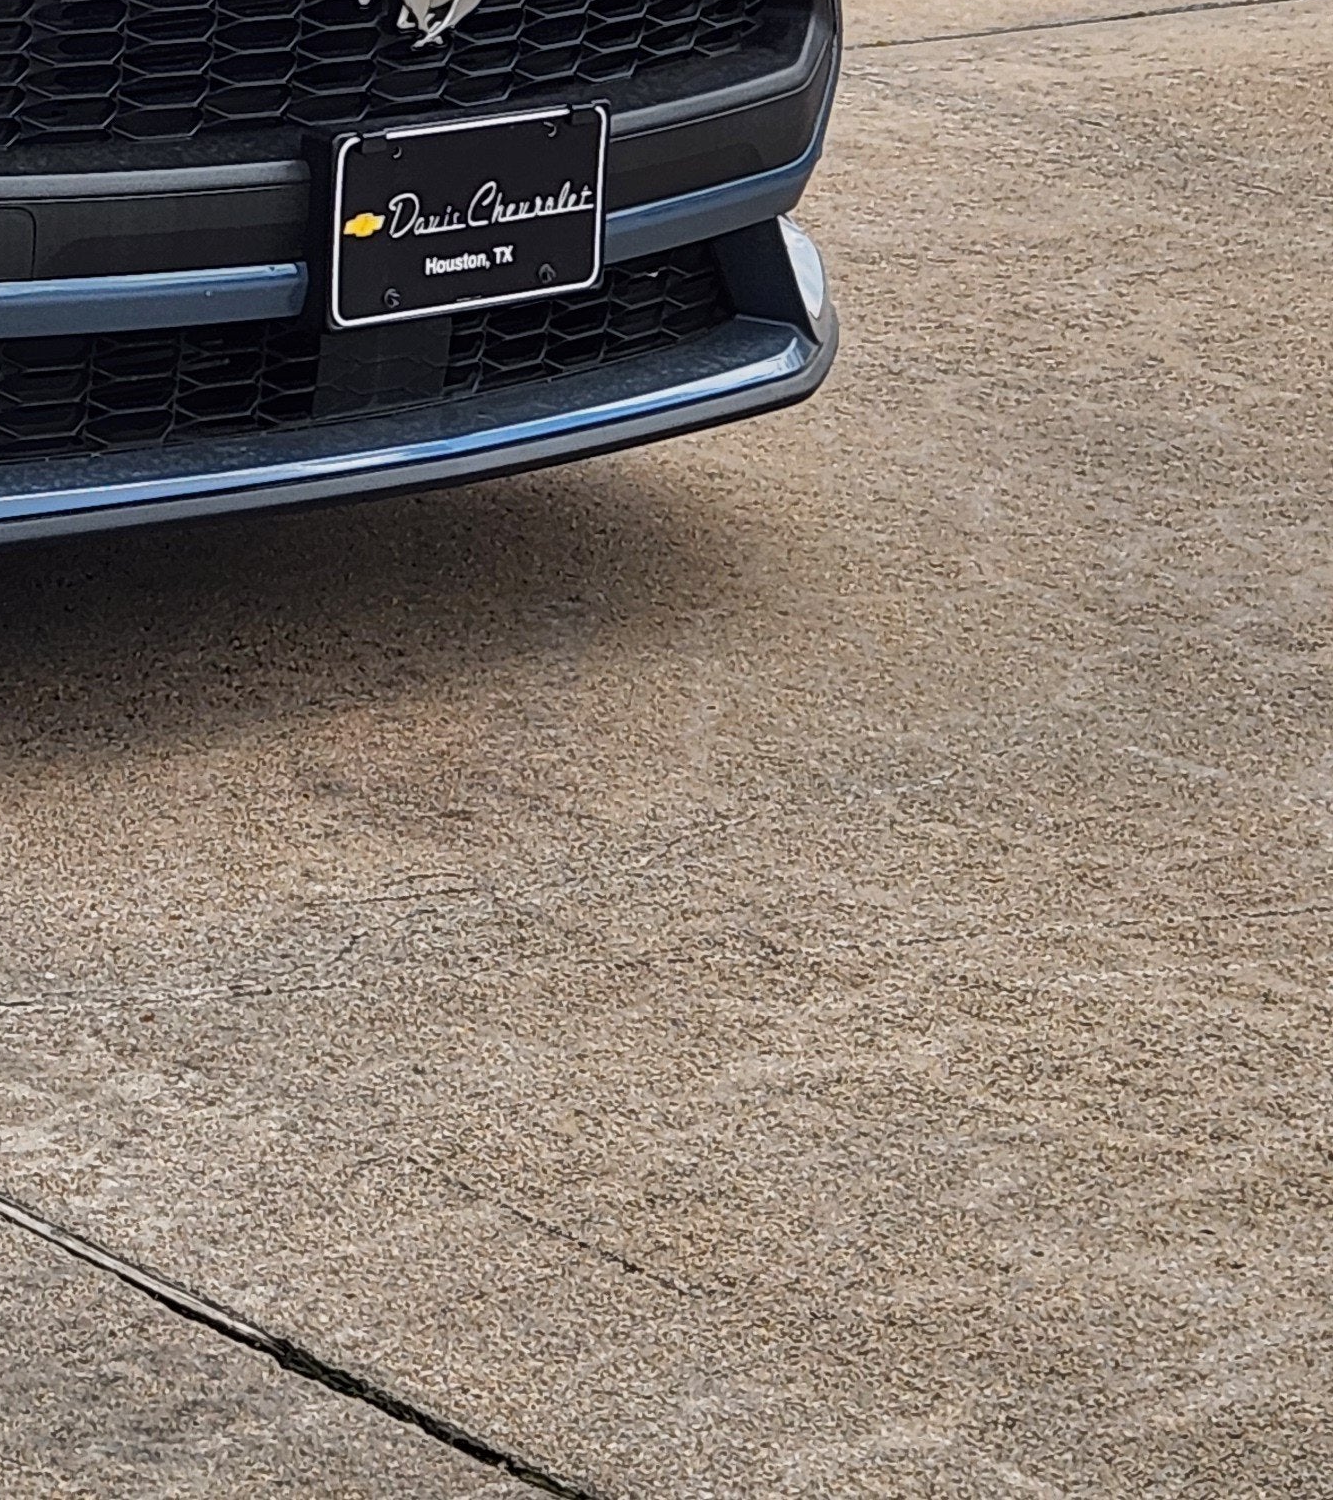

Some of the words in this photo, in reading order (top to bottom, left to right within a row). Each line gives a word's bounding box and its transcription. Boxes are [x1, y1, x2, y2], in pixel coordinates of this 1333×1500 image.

[388, 192, 467, 238] Davis
[467, 180, 595, 227] Chevrolet
[425, 251, 491, 276] Houston,
[492, 245, 514, 266] TX
